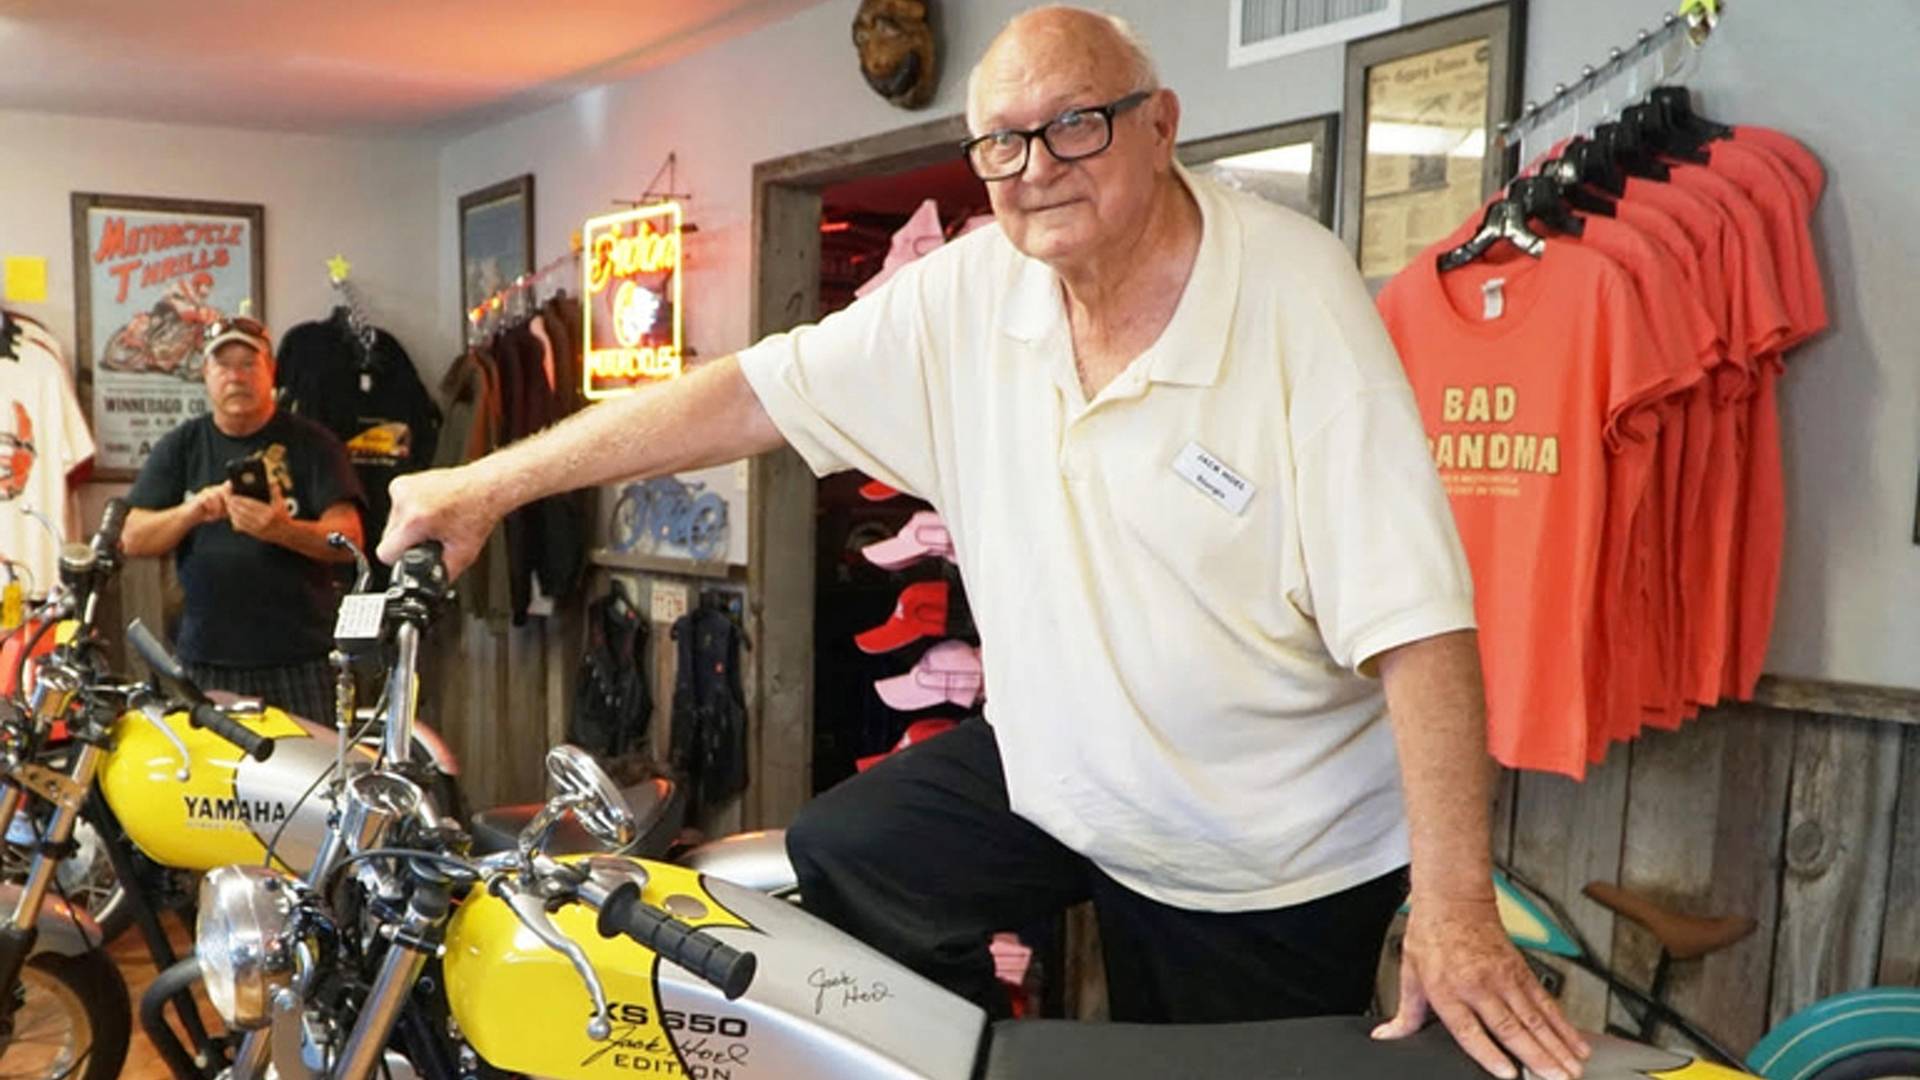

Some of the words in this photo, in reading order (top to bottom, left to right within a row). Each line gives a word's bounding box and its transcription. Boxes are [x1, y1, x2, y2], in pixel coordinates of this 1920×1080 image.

[108, 248, 231, 303] THRILLS
[104, 396, 183, 414] WINNEBAGO
[1442, 385, 1517, 423] BAD
[184, 796, 286, 823] YAMAHA
[662, 1009, 748, 1038] 650
[614, 1053, 732, 1080] EDITION
